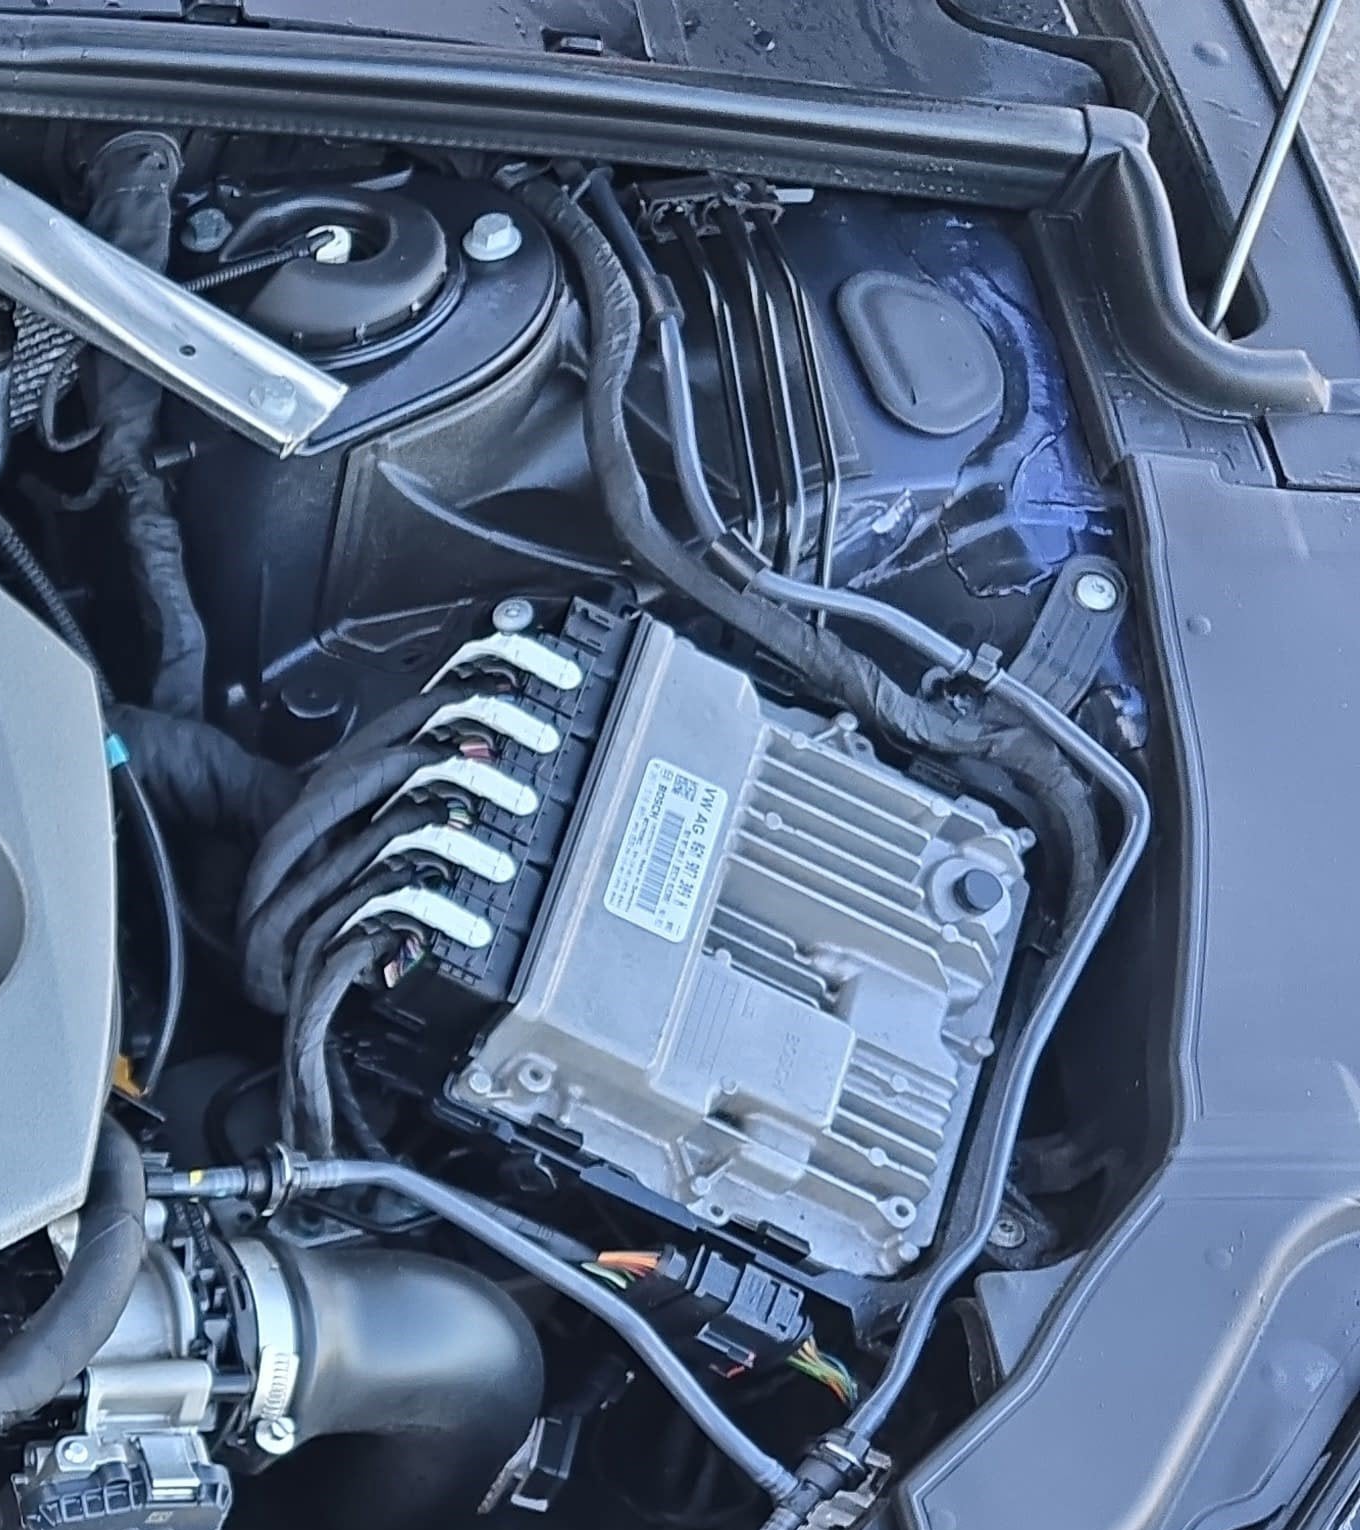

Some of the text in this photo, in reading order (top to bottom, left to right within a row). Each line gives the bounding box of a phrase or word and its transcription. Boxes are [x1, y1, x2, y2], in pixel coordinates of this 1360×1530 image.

[649, 783, 668, 821] BOSCH
[699, 786, 718, 813] VW
[691, 812, 709, 835] AG
